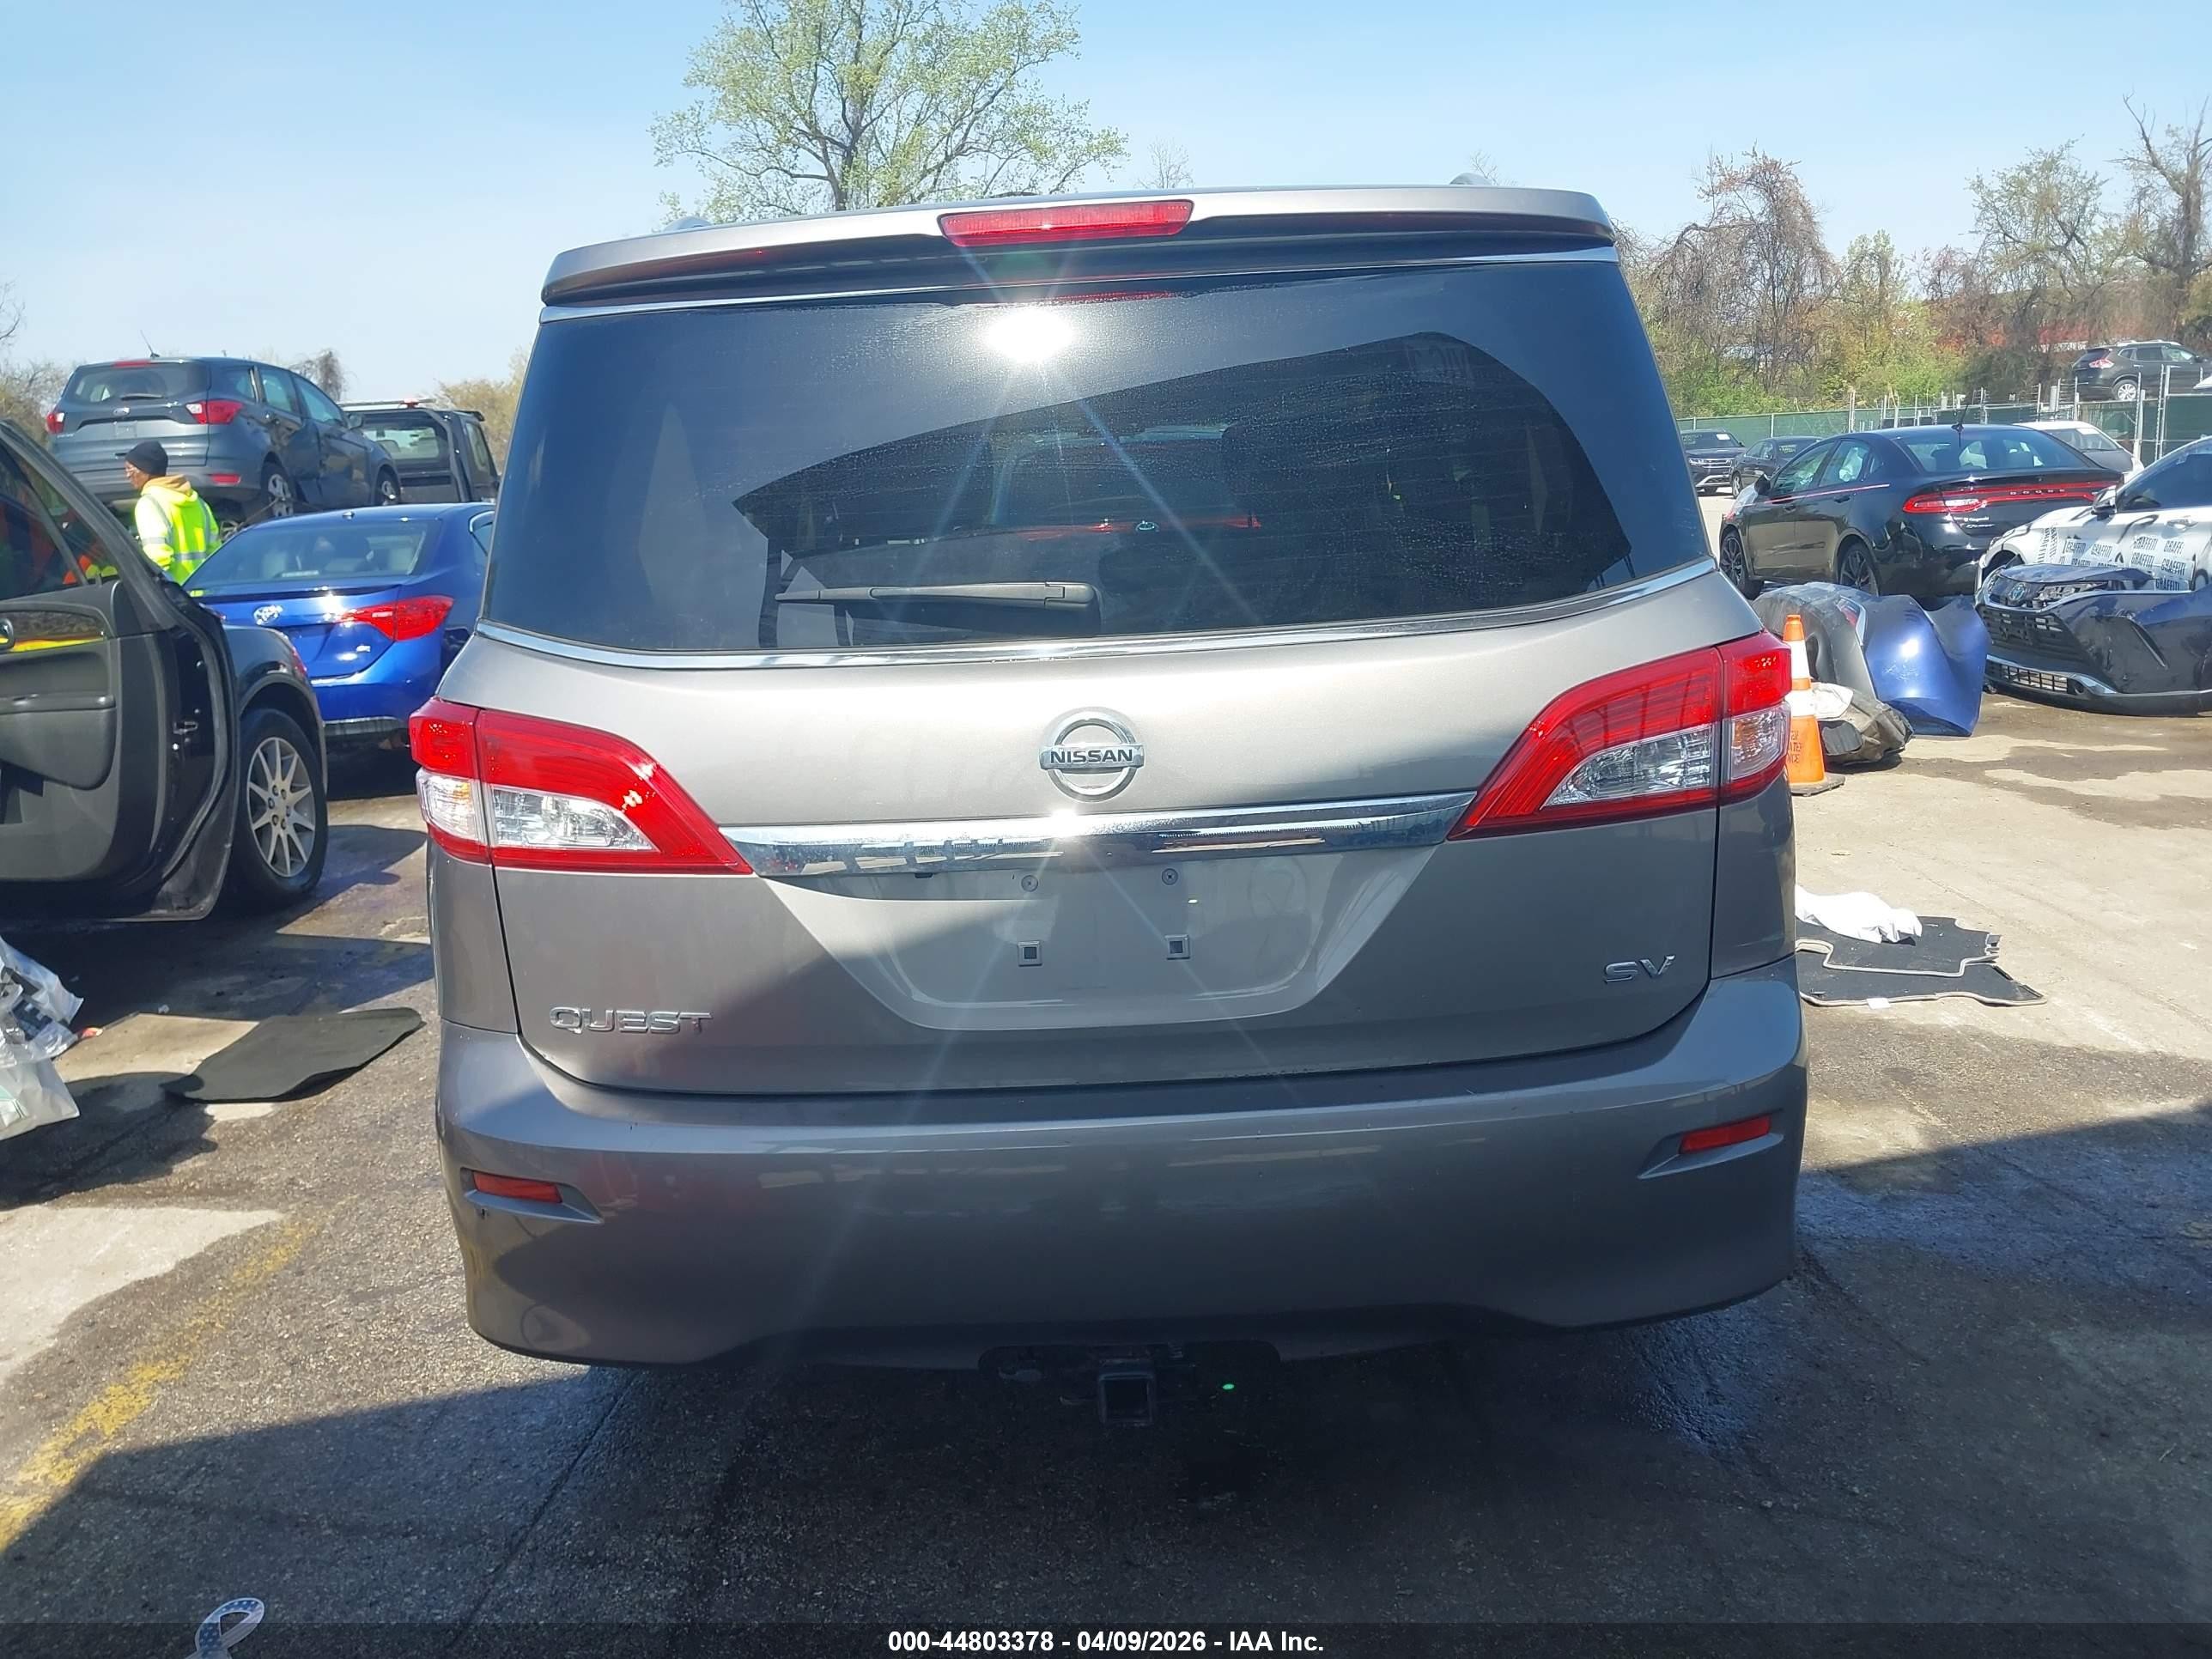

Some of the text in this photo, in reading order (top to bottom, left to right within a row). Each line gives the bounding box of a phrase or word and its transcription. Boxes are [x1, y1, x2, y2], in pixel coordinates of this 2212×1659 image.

[2130, 552, 2155, 568] GRAFFITI
[2160, 558, 2186, 576] GRAFFITI
[2155, 578, 2180, 592] GRAFFITI
[1050, 749, 1133, 764] NISSAN
[1604, 954, 1675, 983] SV
[550, 1006, 713, 1034] QUEST
